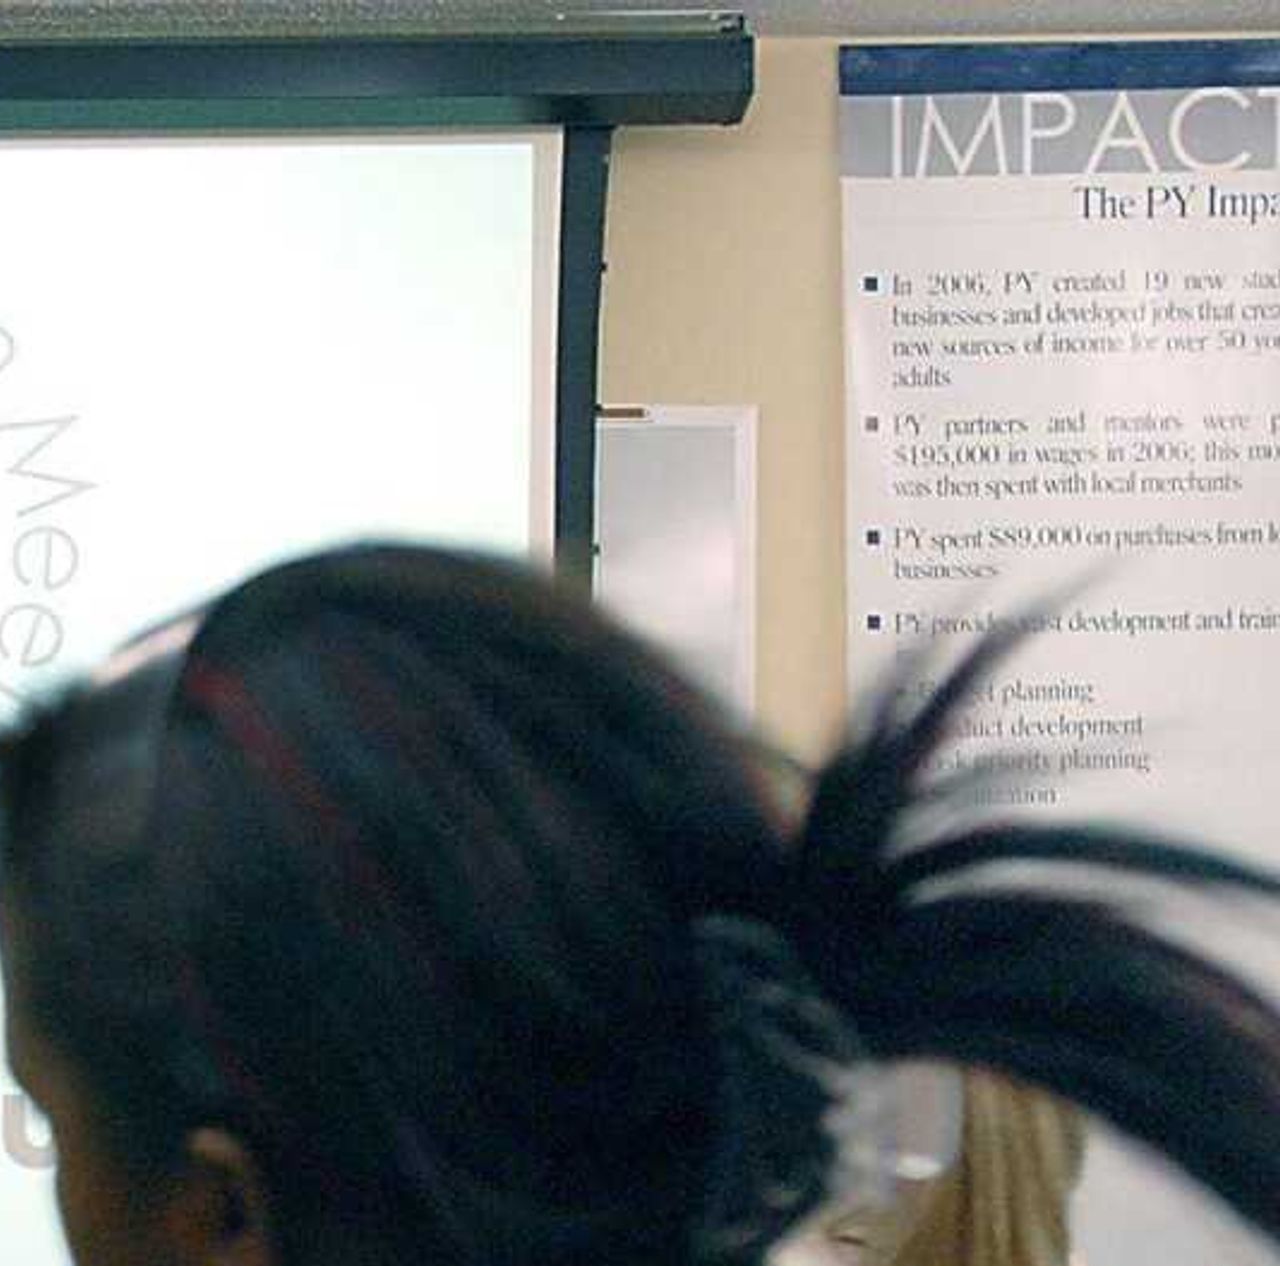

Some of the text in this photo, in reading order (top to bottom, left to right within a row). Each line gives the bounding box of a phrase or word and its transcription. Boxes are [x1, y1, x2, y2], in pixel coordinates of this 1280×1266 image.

[1074, 184, 1280, 225] The PY Impa
[1003, 271, 1038, 293] PY
[1052, 270, 1126, 293] created
[1145, 271, 1169, 290] 19
[1184, 273, 1224, 290] new
[892, 304, 998, 327] businesses
[1003, 303, 1041, 326] and
[1046, 301, 1146, 328] developed
[1151, 301, 1191, 328] jobs
[1197, 301, 1235, 321] that
[942, 339, 1016, 357] sources
[1166, 336, 1208, 351] over
[892, 366, 952, 389] adults
[893, 414, 926, 435] PY
[945, 415, 1029, 442] partners
[1047, 411, 1086, 434] and
[1104, 412, 1185, 433] mentors
[1203, 414, 1251, 430] were
[1008, 444, 1027, 464] in
[1035, 447, 1098, 466] wages
[1107, 443, 1124, 462] in
[1204, 440, 1240, 463] this
[894, 470, 1243, 500] was then spent with local merchants
[894, 526, 926, 549] PY
[930, 529, 982, 556] spent
[1115, 522, 1213, 551] purchases
[1216, 521, 1263, 545] from
[894, 558, 1001, 580] businesses
[1068, 608, 1190, 638] development
[1195, 607, 1232, 631] and
[1001, 677, 1095, 705] planning
[1010, 713, 1143, 742] development
[1059, 747, 1150, 774] planning
